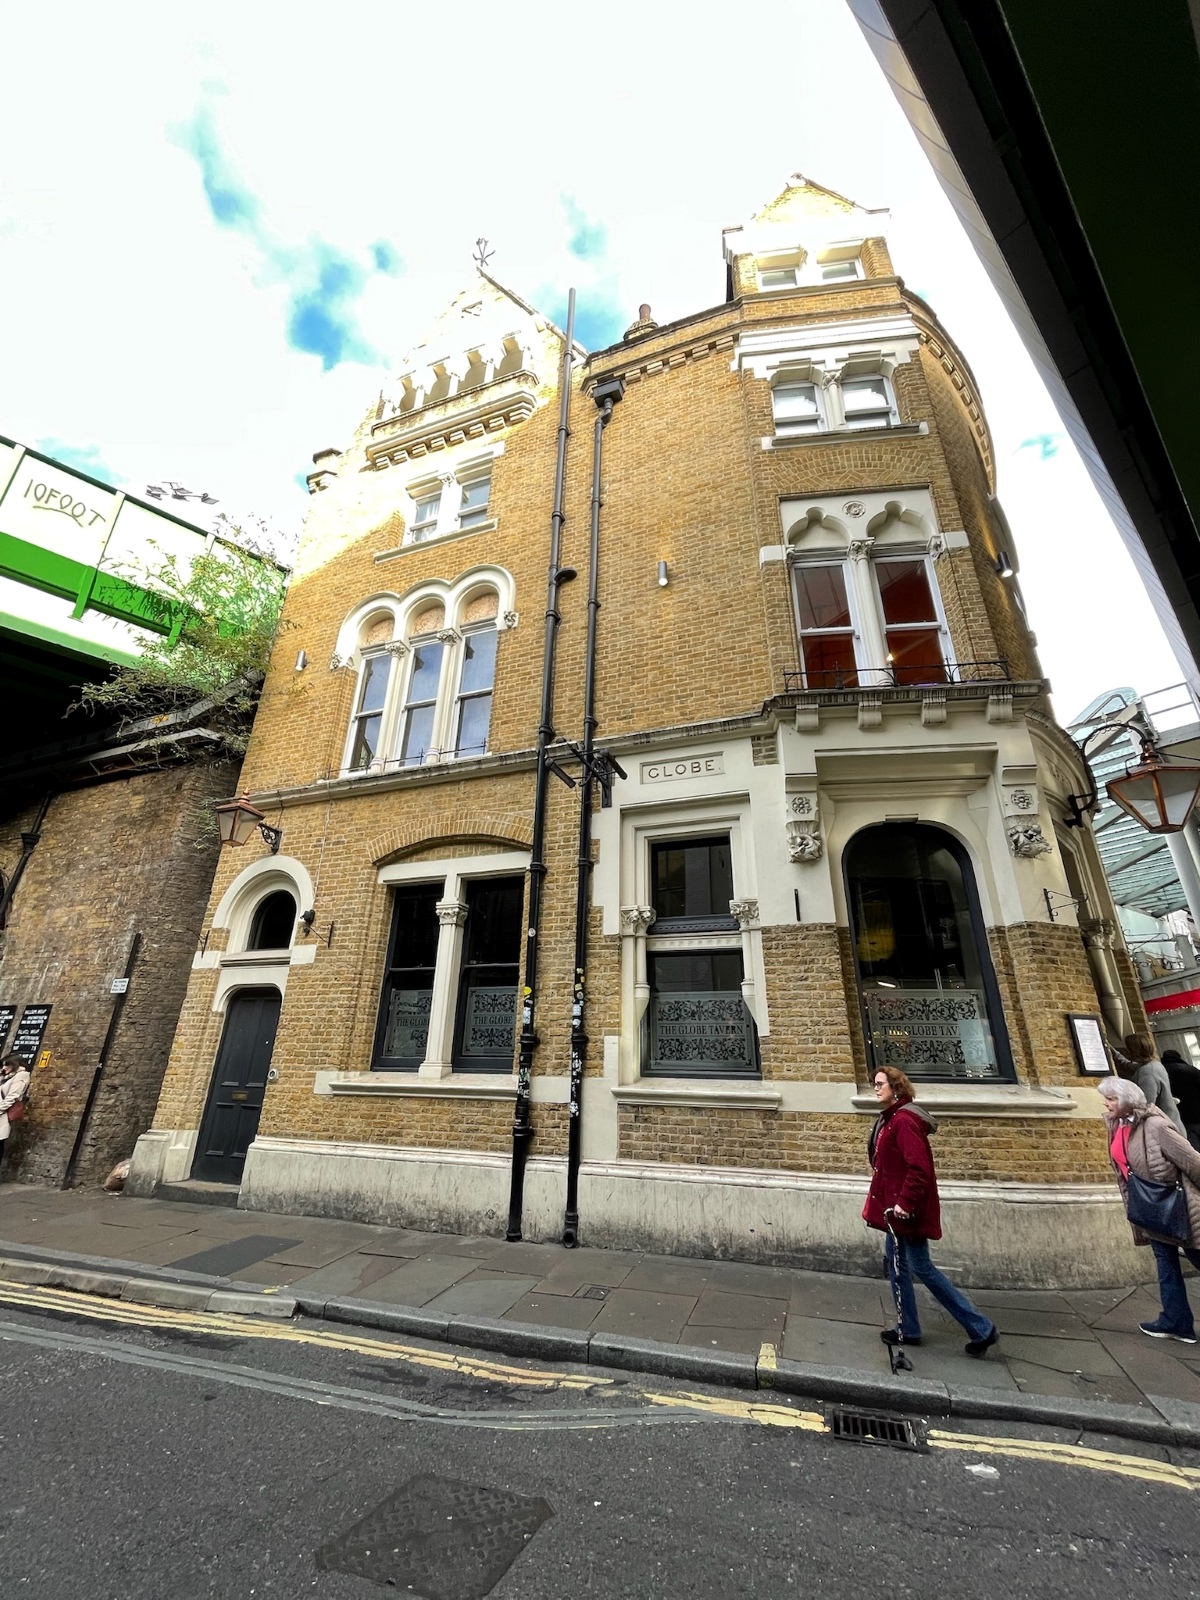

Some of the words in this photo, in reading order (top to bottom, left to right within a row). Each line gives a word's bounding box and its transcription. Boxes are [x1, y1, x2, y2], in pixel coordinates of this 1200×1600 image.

[474, 1016, 488, 1025] THE
[488, 1015, 513, 1024] GLOBE
[659, 1025, 677, 1035] THE
[678, 1025, 707, 1035] GLOBE
[708, 1024, 743, 1035] TAVERN
[903, 1025, 938, 1036] GLOBE
[939, 1025, 979, 1036] TAVN
